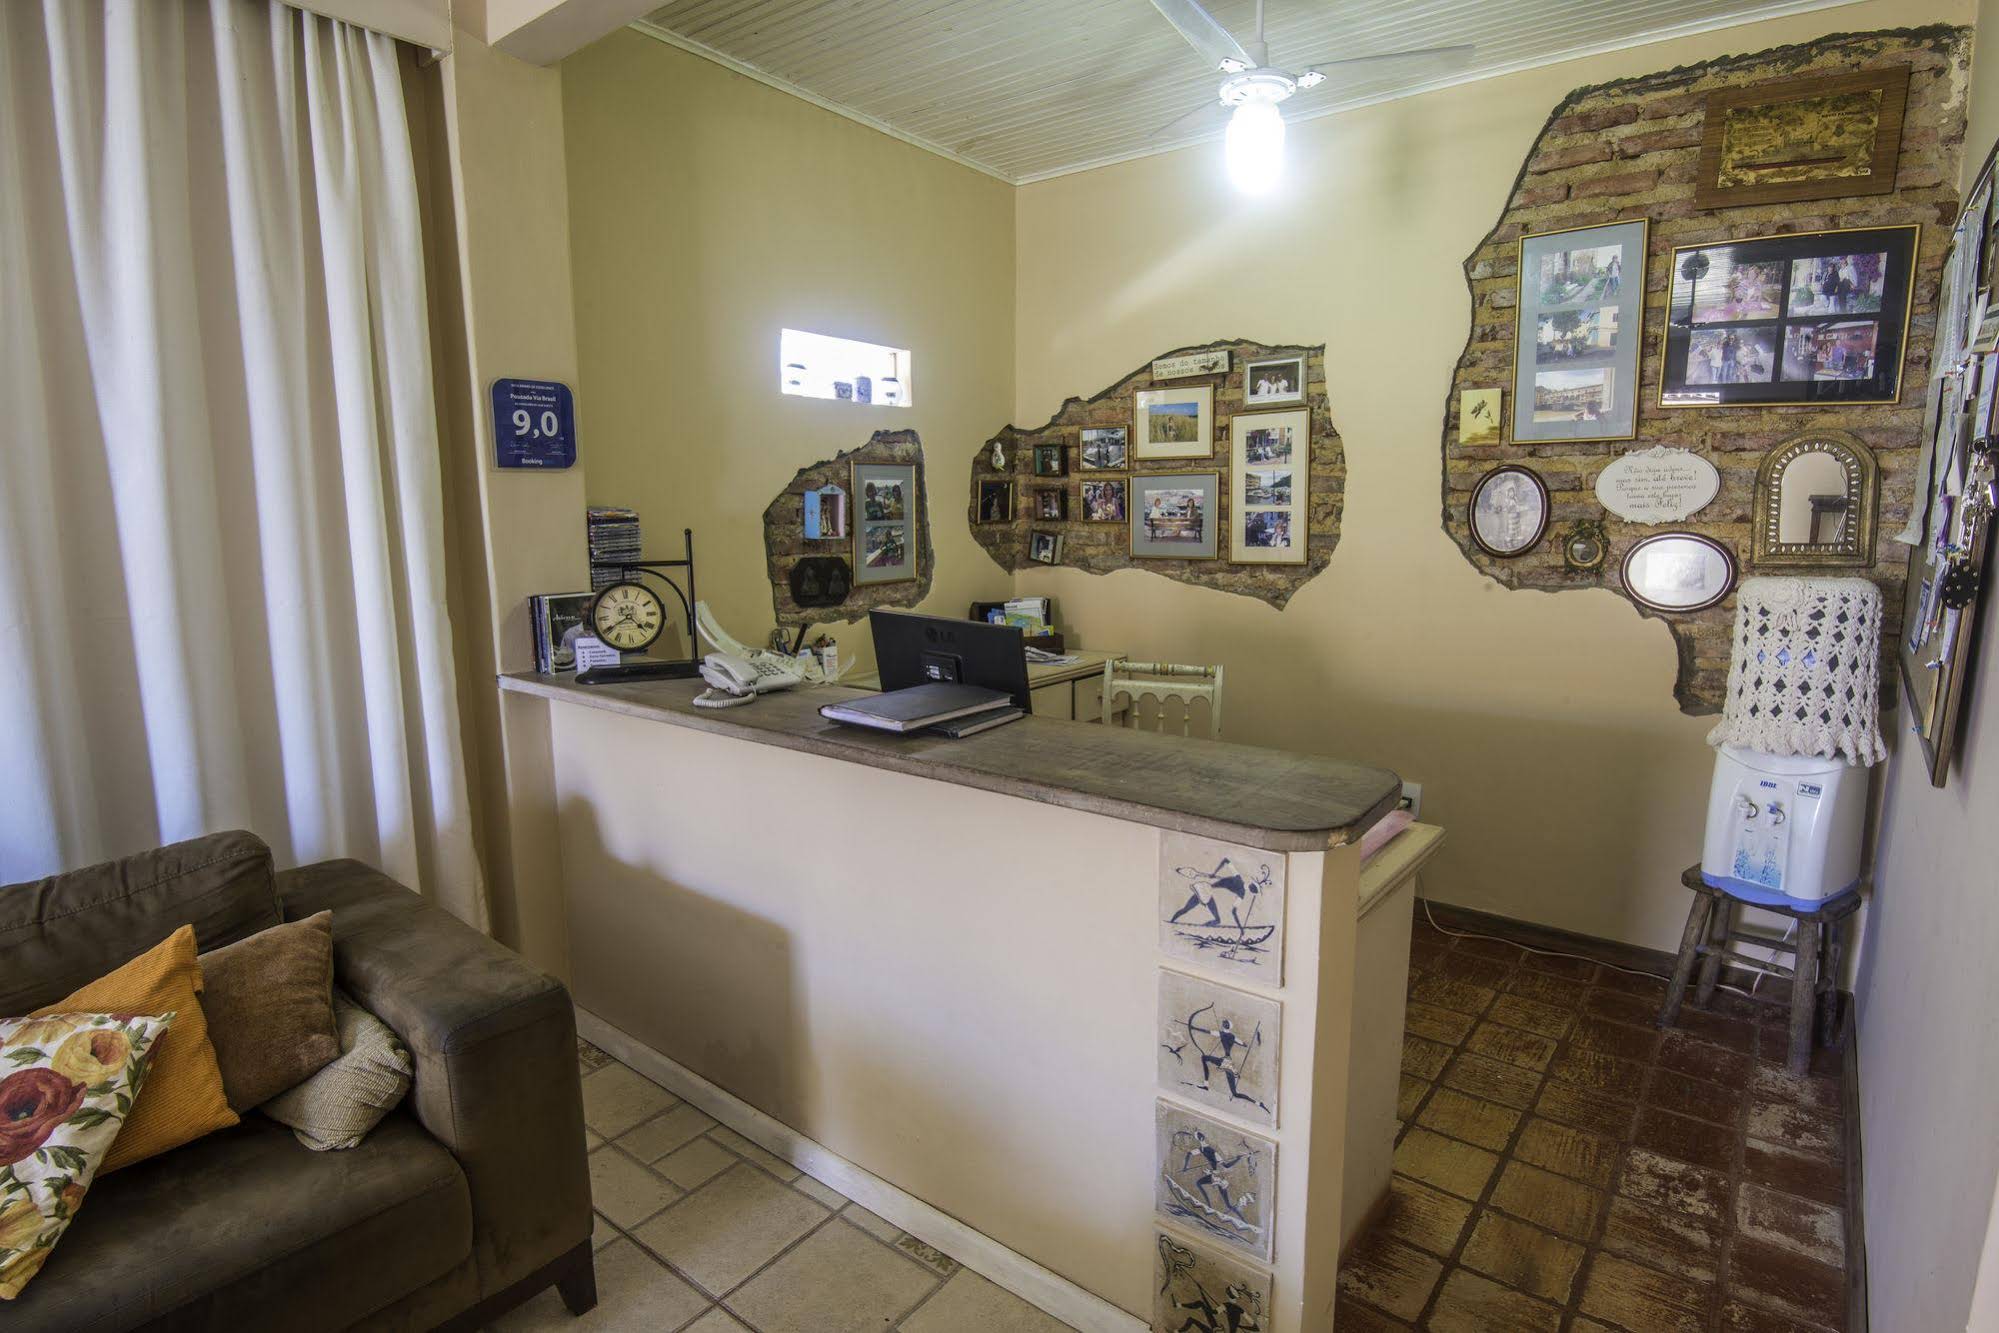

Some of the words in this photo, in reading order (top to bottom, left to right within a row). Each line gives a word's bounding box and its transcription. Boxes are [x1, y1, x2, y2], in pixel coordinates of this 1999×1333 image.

[1154, 362, 1176, 370] Somos
[1193, 355, 1225, 365] tamanho
[1167, 368, 1194, 376] nossos
[512, 409, 558, 438] 9,0
[1653, 474, 1666, 482] até
